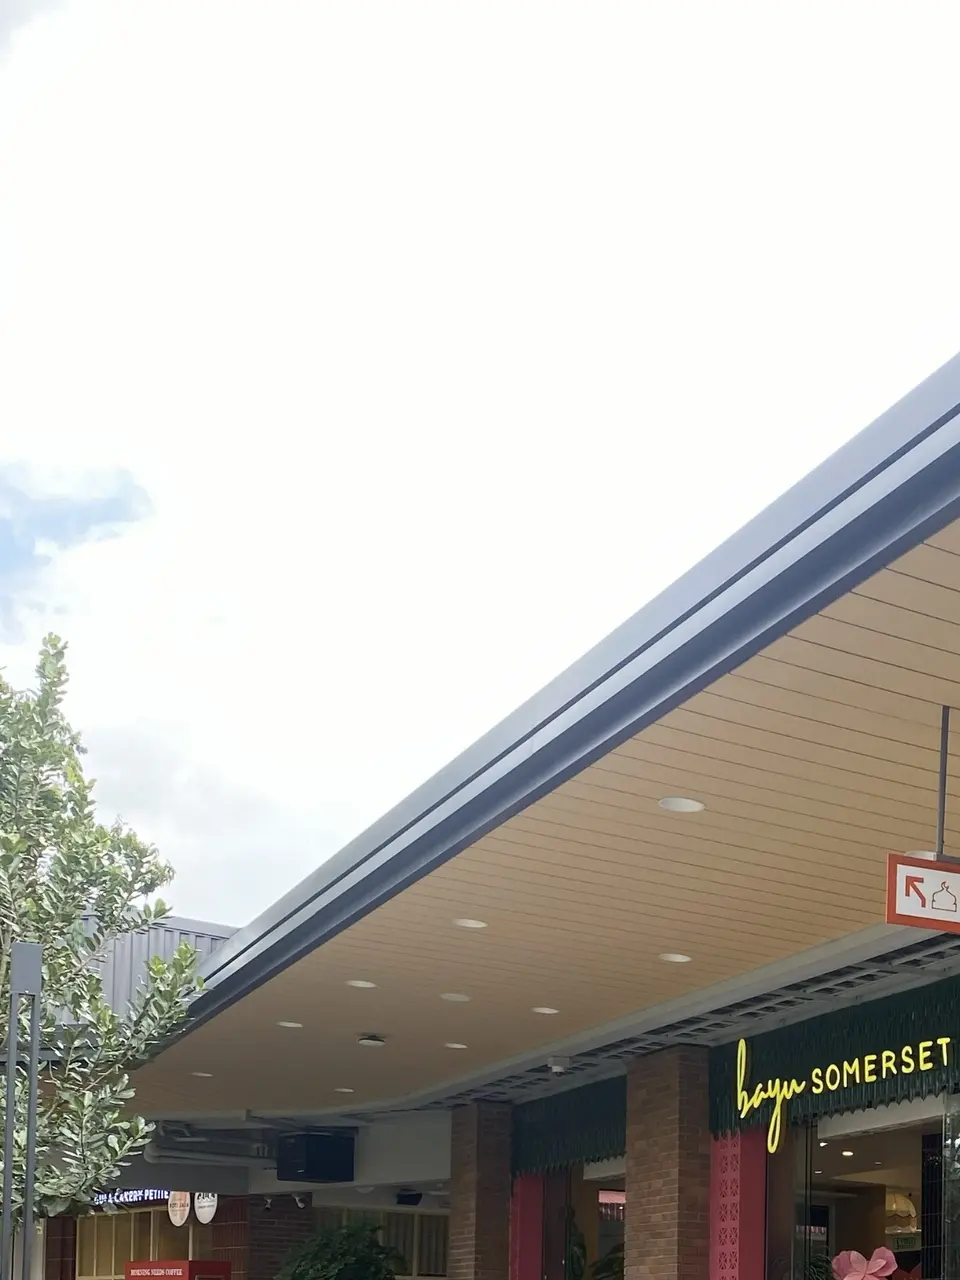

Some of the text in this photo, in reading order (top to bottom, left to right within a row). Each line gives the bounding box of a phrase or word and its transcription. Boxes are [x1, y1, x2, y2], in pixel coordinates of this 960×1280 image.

[811, 1036, 952, 1095] SOMERSET
[130, 1268, 183, 1276] MORNING NEEDS COFFEE
